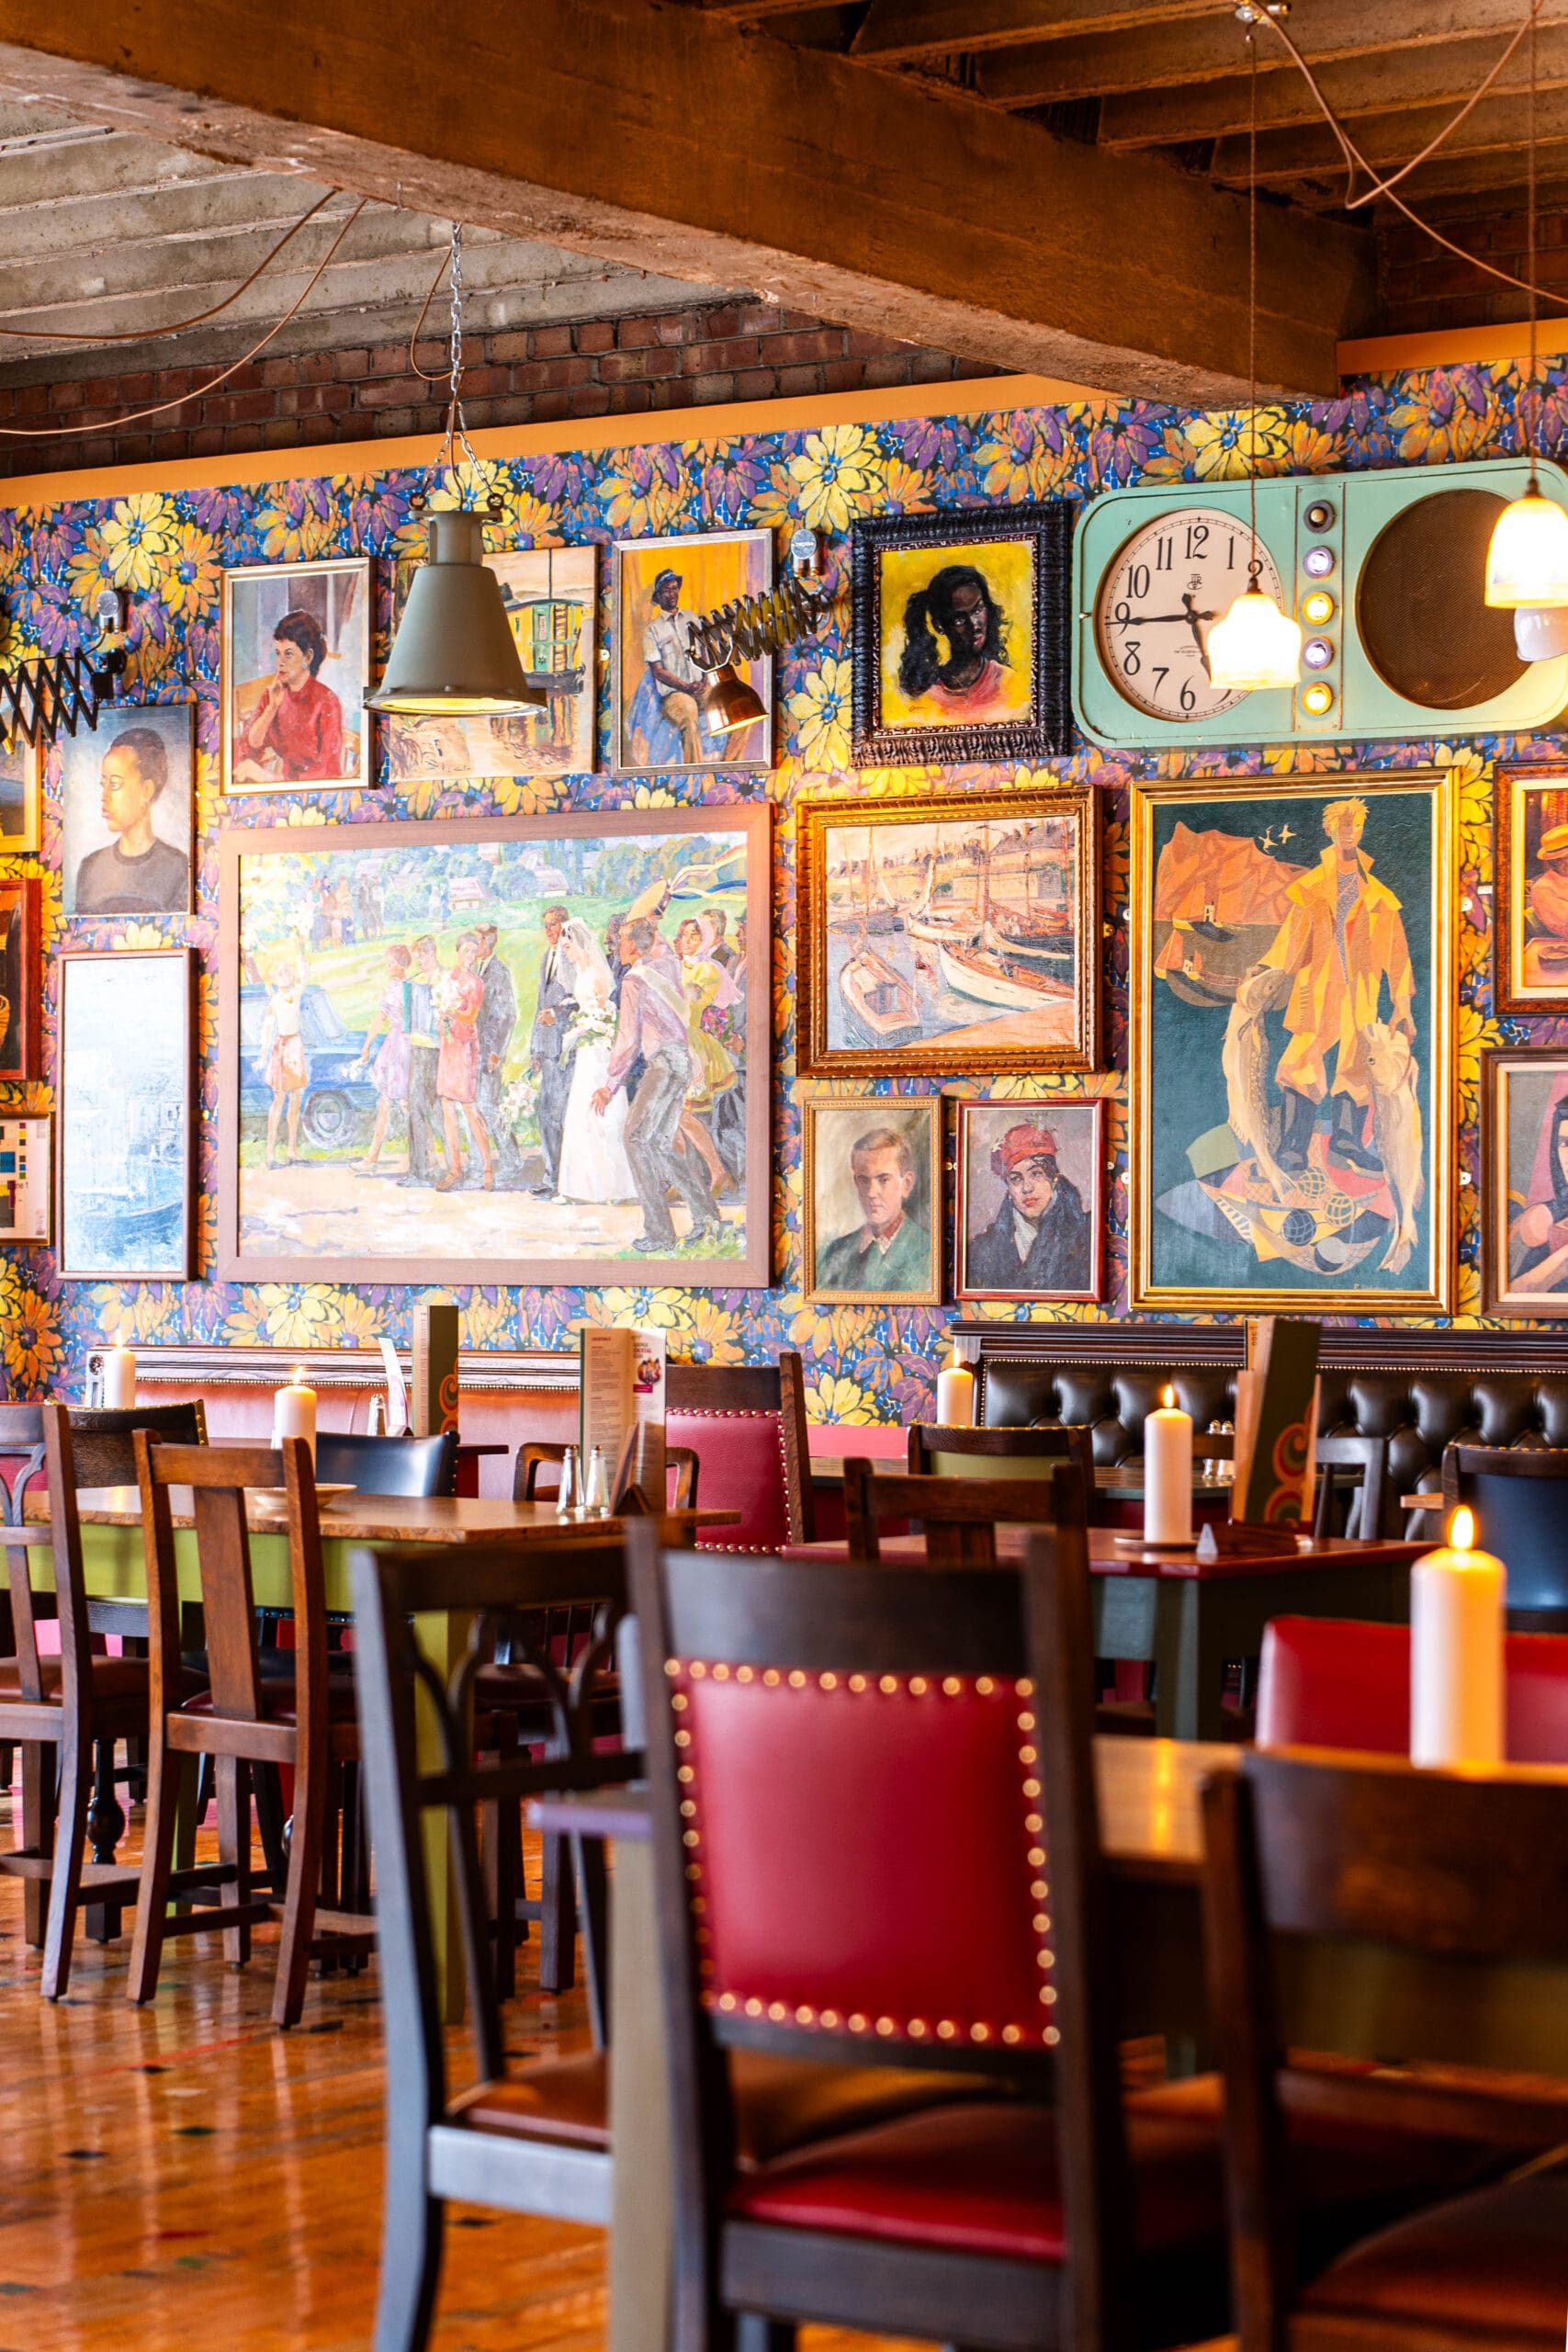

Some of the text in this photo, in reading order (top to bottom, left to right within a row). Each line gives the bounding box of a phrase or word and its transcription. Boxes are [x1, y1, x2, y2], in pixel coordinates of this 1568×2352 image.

[1156, 537, 1173, 571] 11
[1185, 526, 1209, 560] 12
[1226, 536, 1235, 570] 1
[1126, 564, 1150, 598] 10
[1114, 602, 1131, 638] 9
[1123, 641, 1141, 675] 8
[1152, 667, 1169, 701] 7
[1180, 675, 1196, 711] 6
